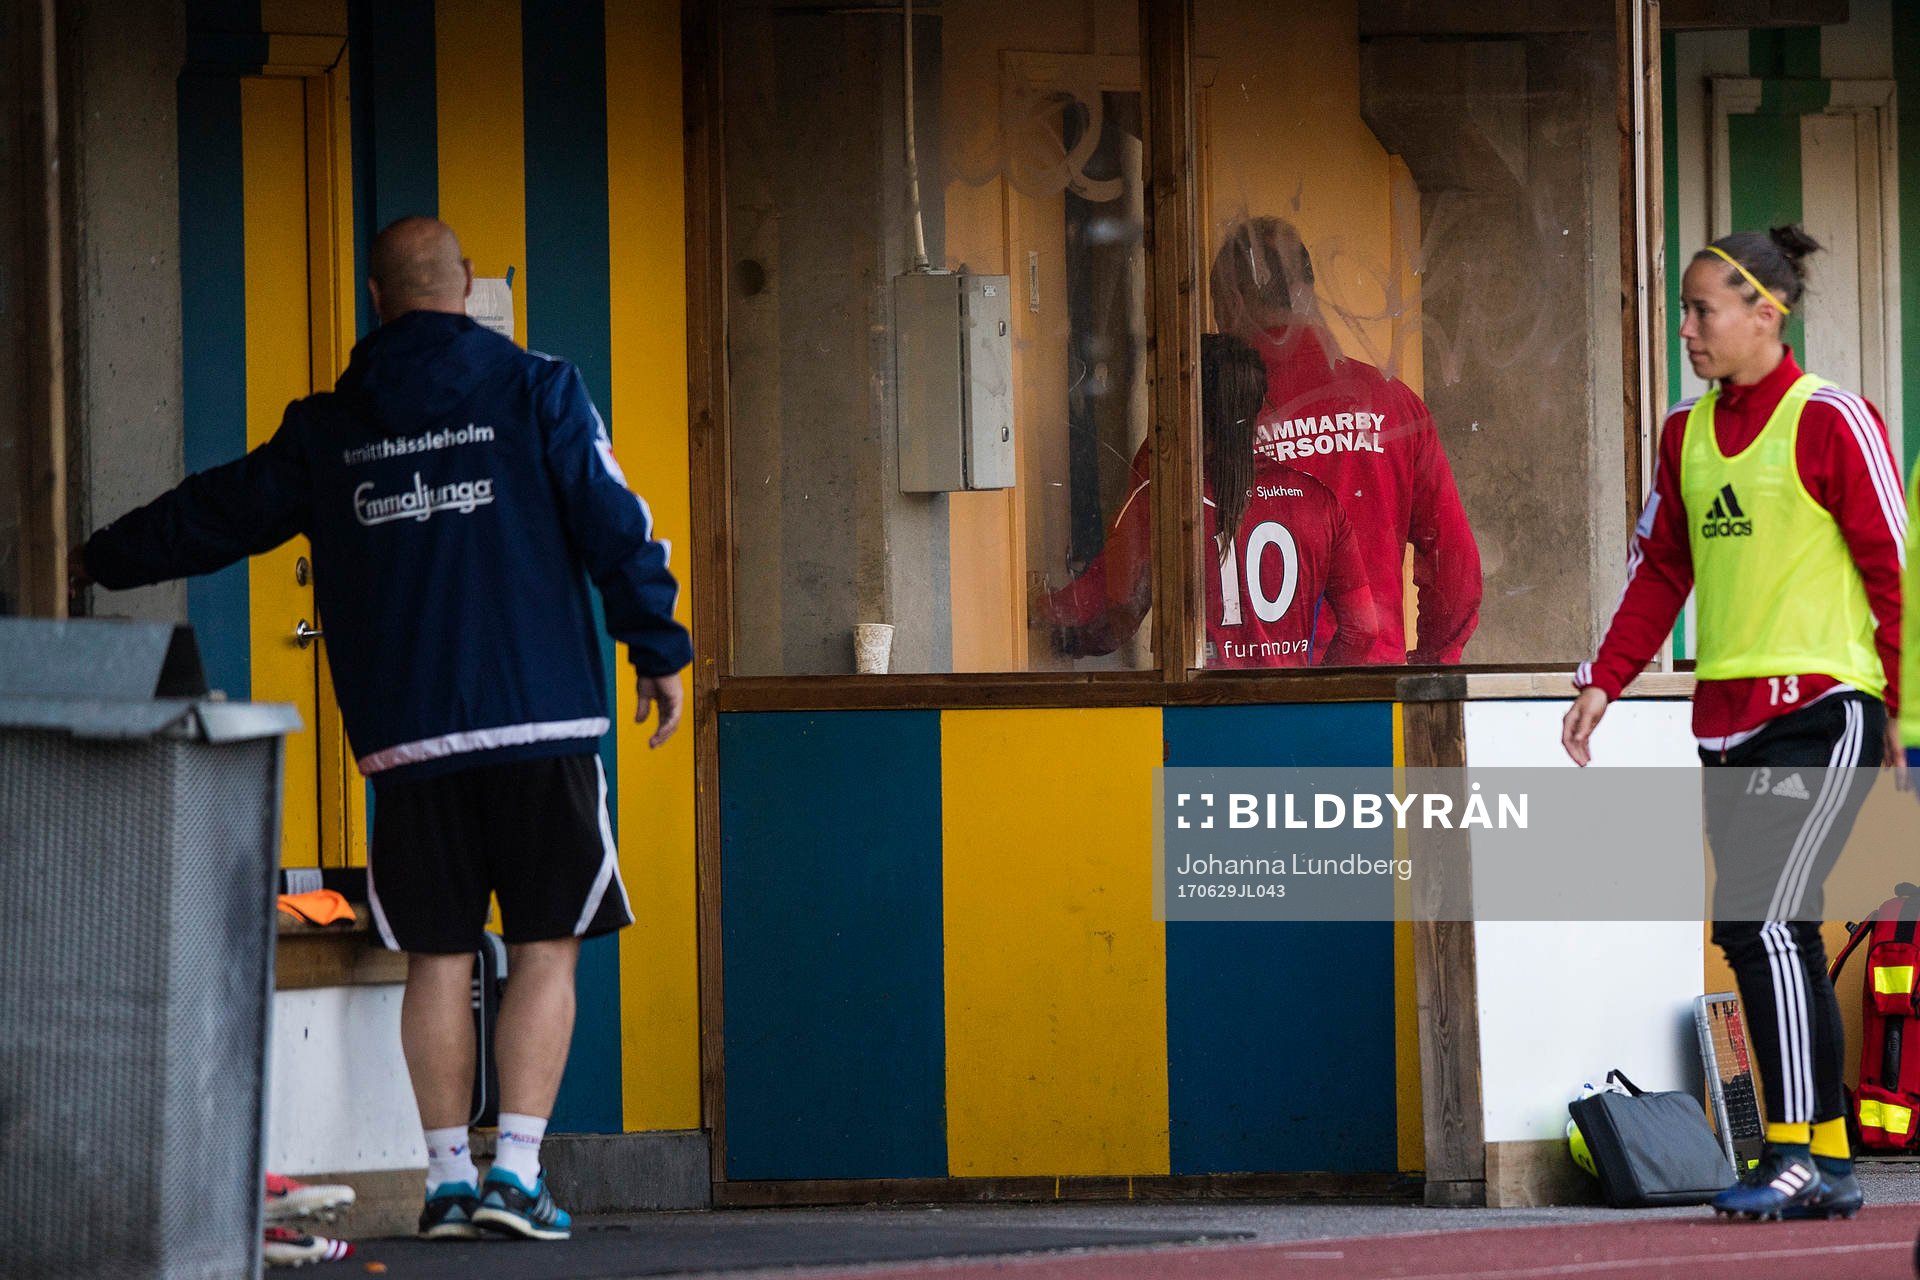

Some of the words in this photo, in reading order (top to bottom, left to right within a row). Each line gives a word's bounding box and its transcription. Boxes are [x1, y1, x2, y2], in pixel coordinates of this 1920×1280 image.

[1255, 411, 1385, 445] AMMARBY
[354, 471, 495, 526] Emmaljunga
[1256, 486, 1304, 500] Sjukhem
[1213, 520, 1299, 626] 10
[1768, 675, 1800, 706] 13
